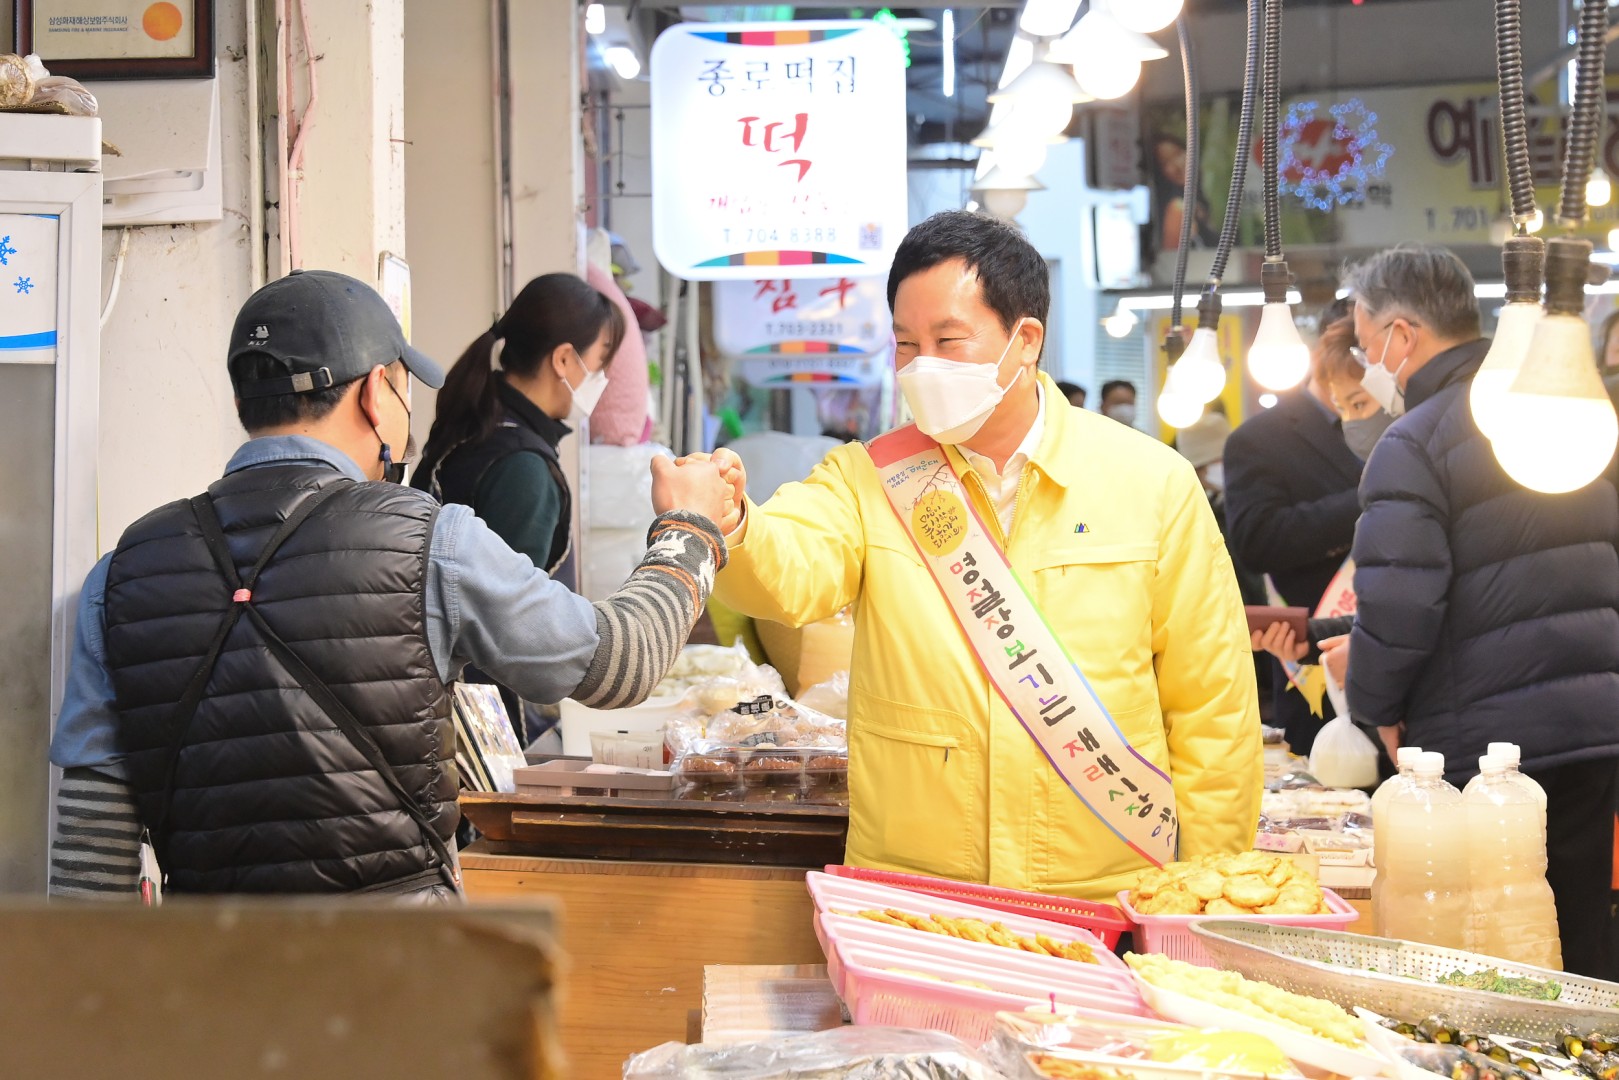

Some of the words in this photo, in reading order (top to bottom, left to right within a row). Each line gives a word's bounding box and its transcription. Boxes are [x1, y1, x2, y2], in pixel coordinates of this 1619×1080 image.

[48, 16, 128, 26] 삼성화재해상보험주식회사
[697, 55, 857, 97] 종로떡집
[736, 112, 813, 184] 떡
[949, 551, 1076, 727] 명절장보기는
[1062, 727, 1154, 819] 재래시장
